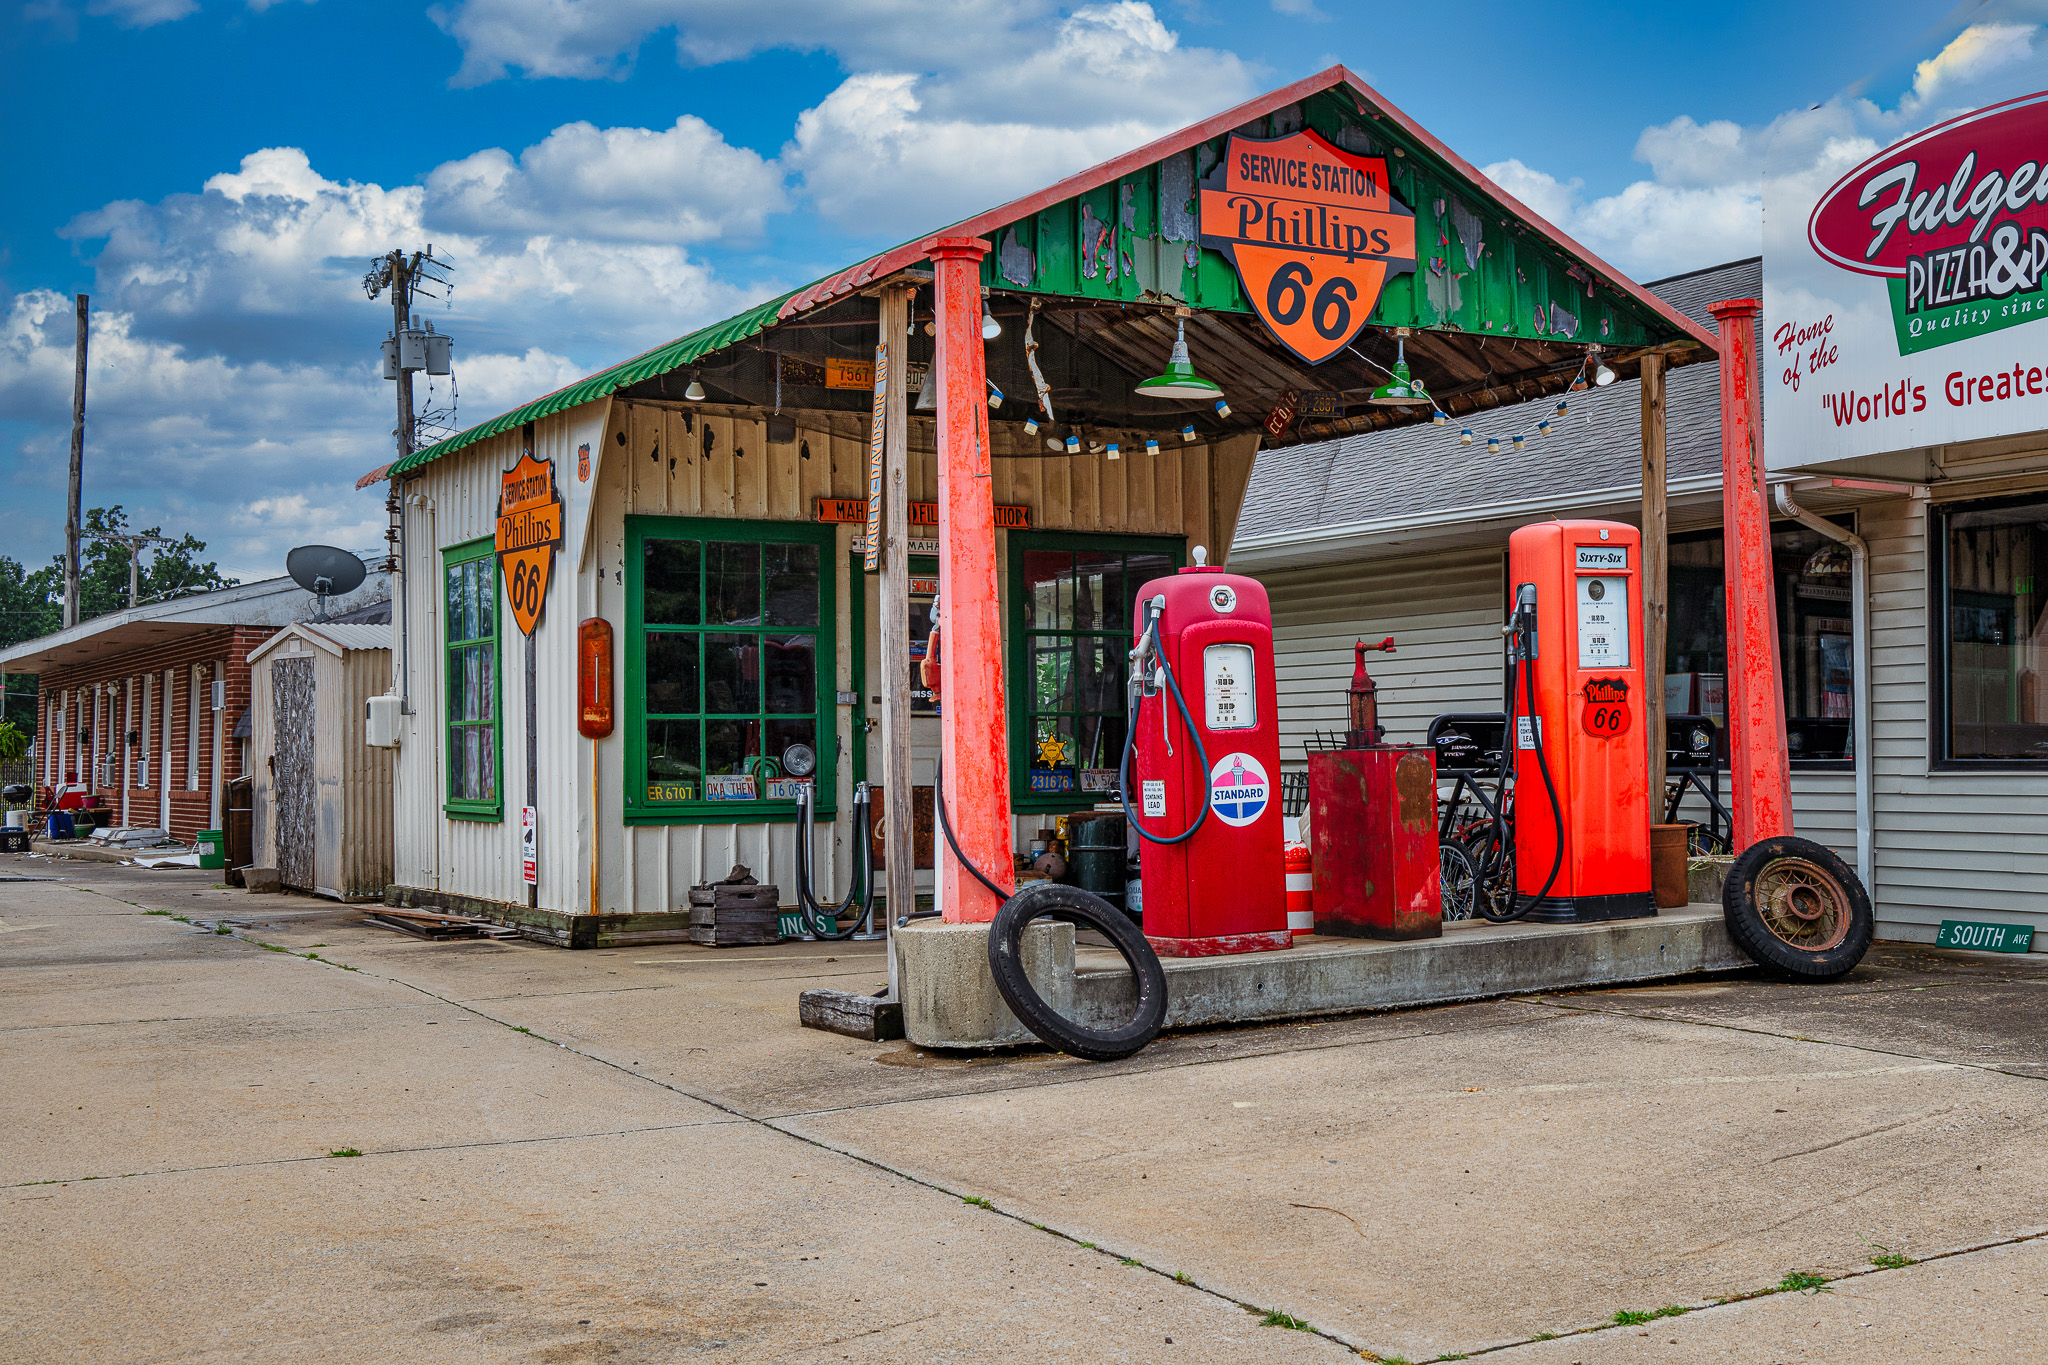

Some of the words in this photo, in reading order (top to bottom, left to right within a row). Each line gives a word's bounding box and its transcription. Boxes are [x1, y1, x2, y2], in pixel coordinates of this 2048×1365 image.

[1240, 152, 1308, 189] SERVICE
[1311, 163, 1377, 198] STATION
[1227, 196, 1391, 264] Phillips
[1266, 261, 1358, 341] 66
[1773, 314, 1834, 357] Home
[1909, 308, 1991, 338] Quality
[838, 365, 869, 382] 7567
[1783, 354, 1802, 392] of
[1808, 341, 1839, 374] the
[1822, 377, 1927, 427] "World's
[1945, 362, 2048, 406] Greate
[505, 478, 525, 506] SERVICE
[525, 472, 548, 500] STATION
[866, 392, 886, 564] HARLEY-DAVIDSON
[501, 511, 552, 553] Phillips
[512, 558, 541, 617] 66
[2016, 576, 2035, 594] EXIT
[1587, 684, 1625, 705] Phillips
[1594, 708, 1622, 731] 66
[666, 787, 692, 800] 6707
[706, 783, 725, 796] OKA
[731, 782, 754, 796] THEN
[773, 783, 784, 796] 16
[1031, 775, 1069, 789] 231676
[1214, 787, 1264, 801] STANDARD
[1939, 928, 1946, 939] E
[1950, 925, 2006, 948] SOUTH
[2012, 934, 2030, 945] AVE
